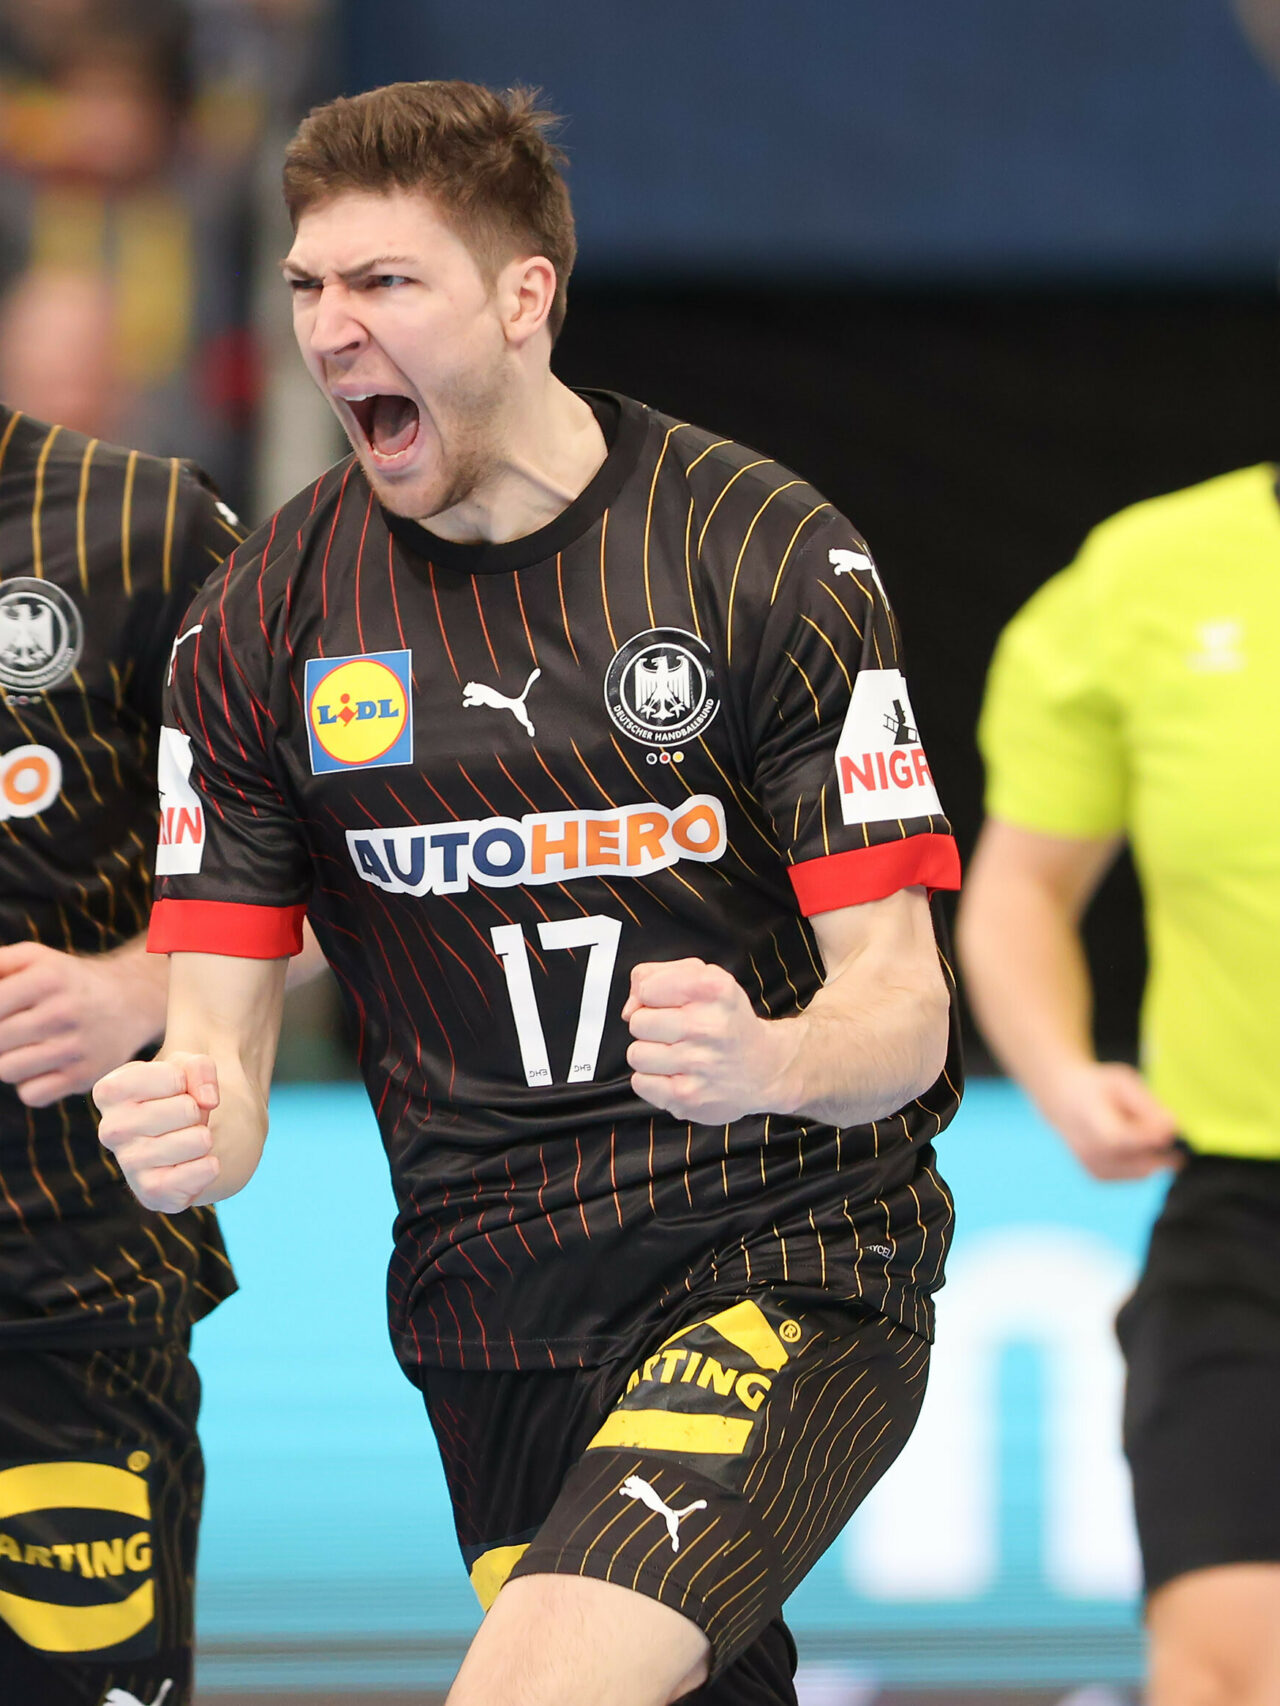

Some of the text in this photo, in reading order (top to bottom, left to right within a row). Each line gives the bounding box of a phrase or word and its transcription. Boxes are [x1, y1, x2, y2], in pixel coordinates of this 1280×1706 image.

[613, 698, 714, 741] DEUTSCHER HANDBALLBUND
[354, 804, 721, 887] AUTOHERO
[490, 914, 622, 1087] 17
